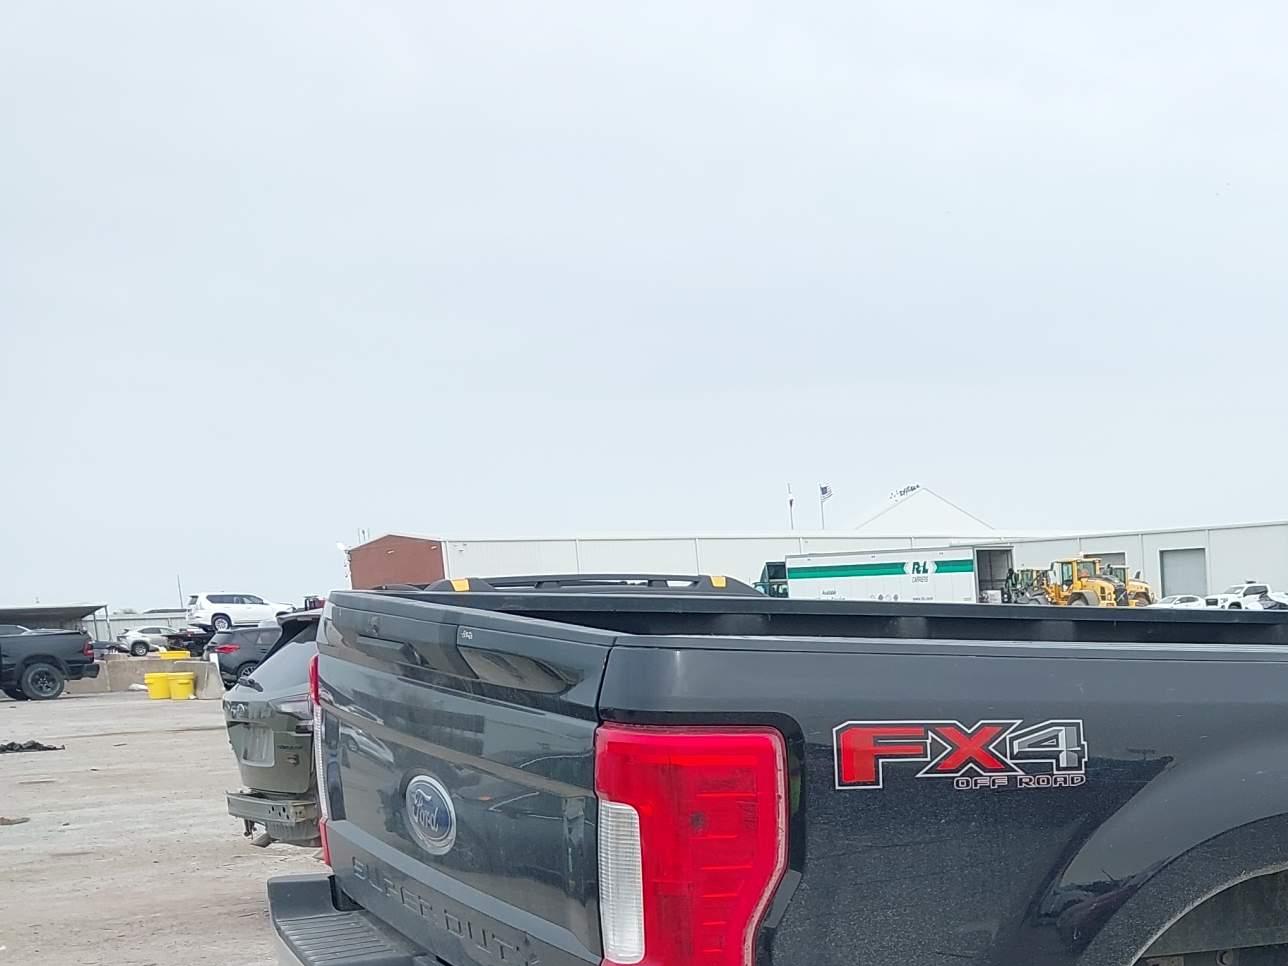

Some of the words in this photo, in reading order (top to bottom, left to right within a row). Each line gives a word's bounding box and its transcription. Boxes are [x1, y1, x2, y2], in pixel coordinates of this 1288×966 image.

[832, 719, 1088, 789] FX4
[954, 776, 1009, 790] OFF
[1017, 774, 1087, 788] ROAD
